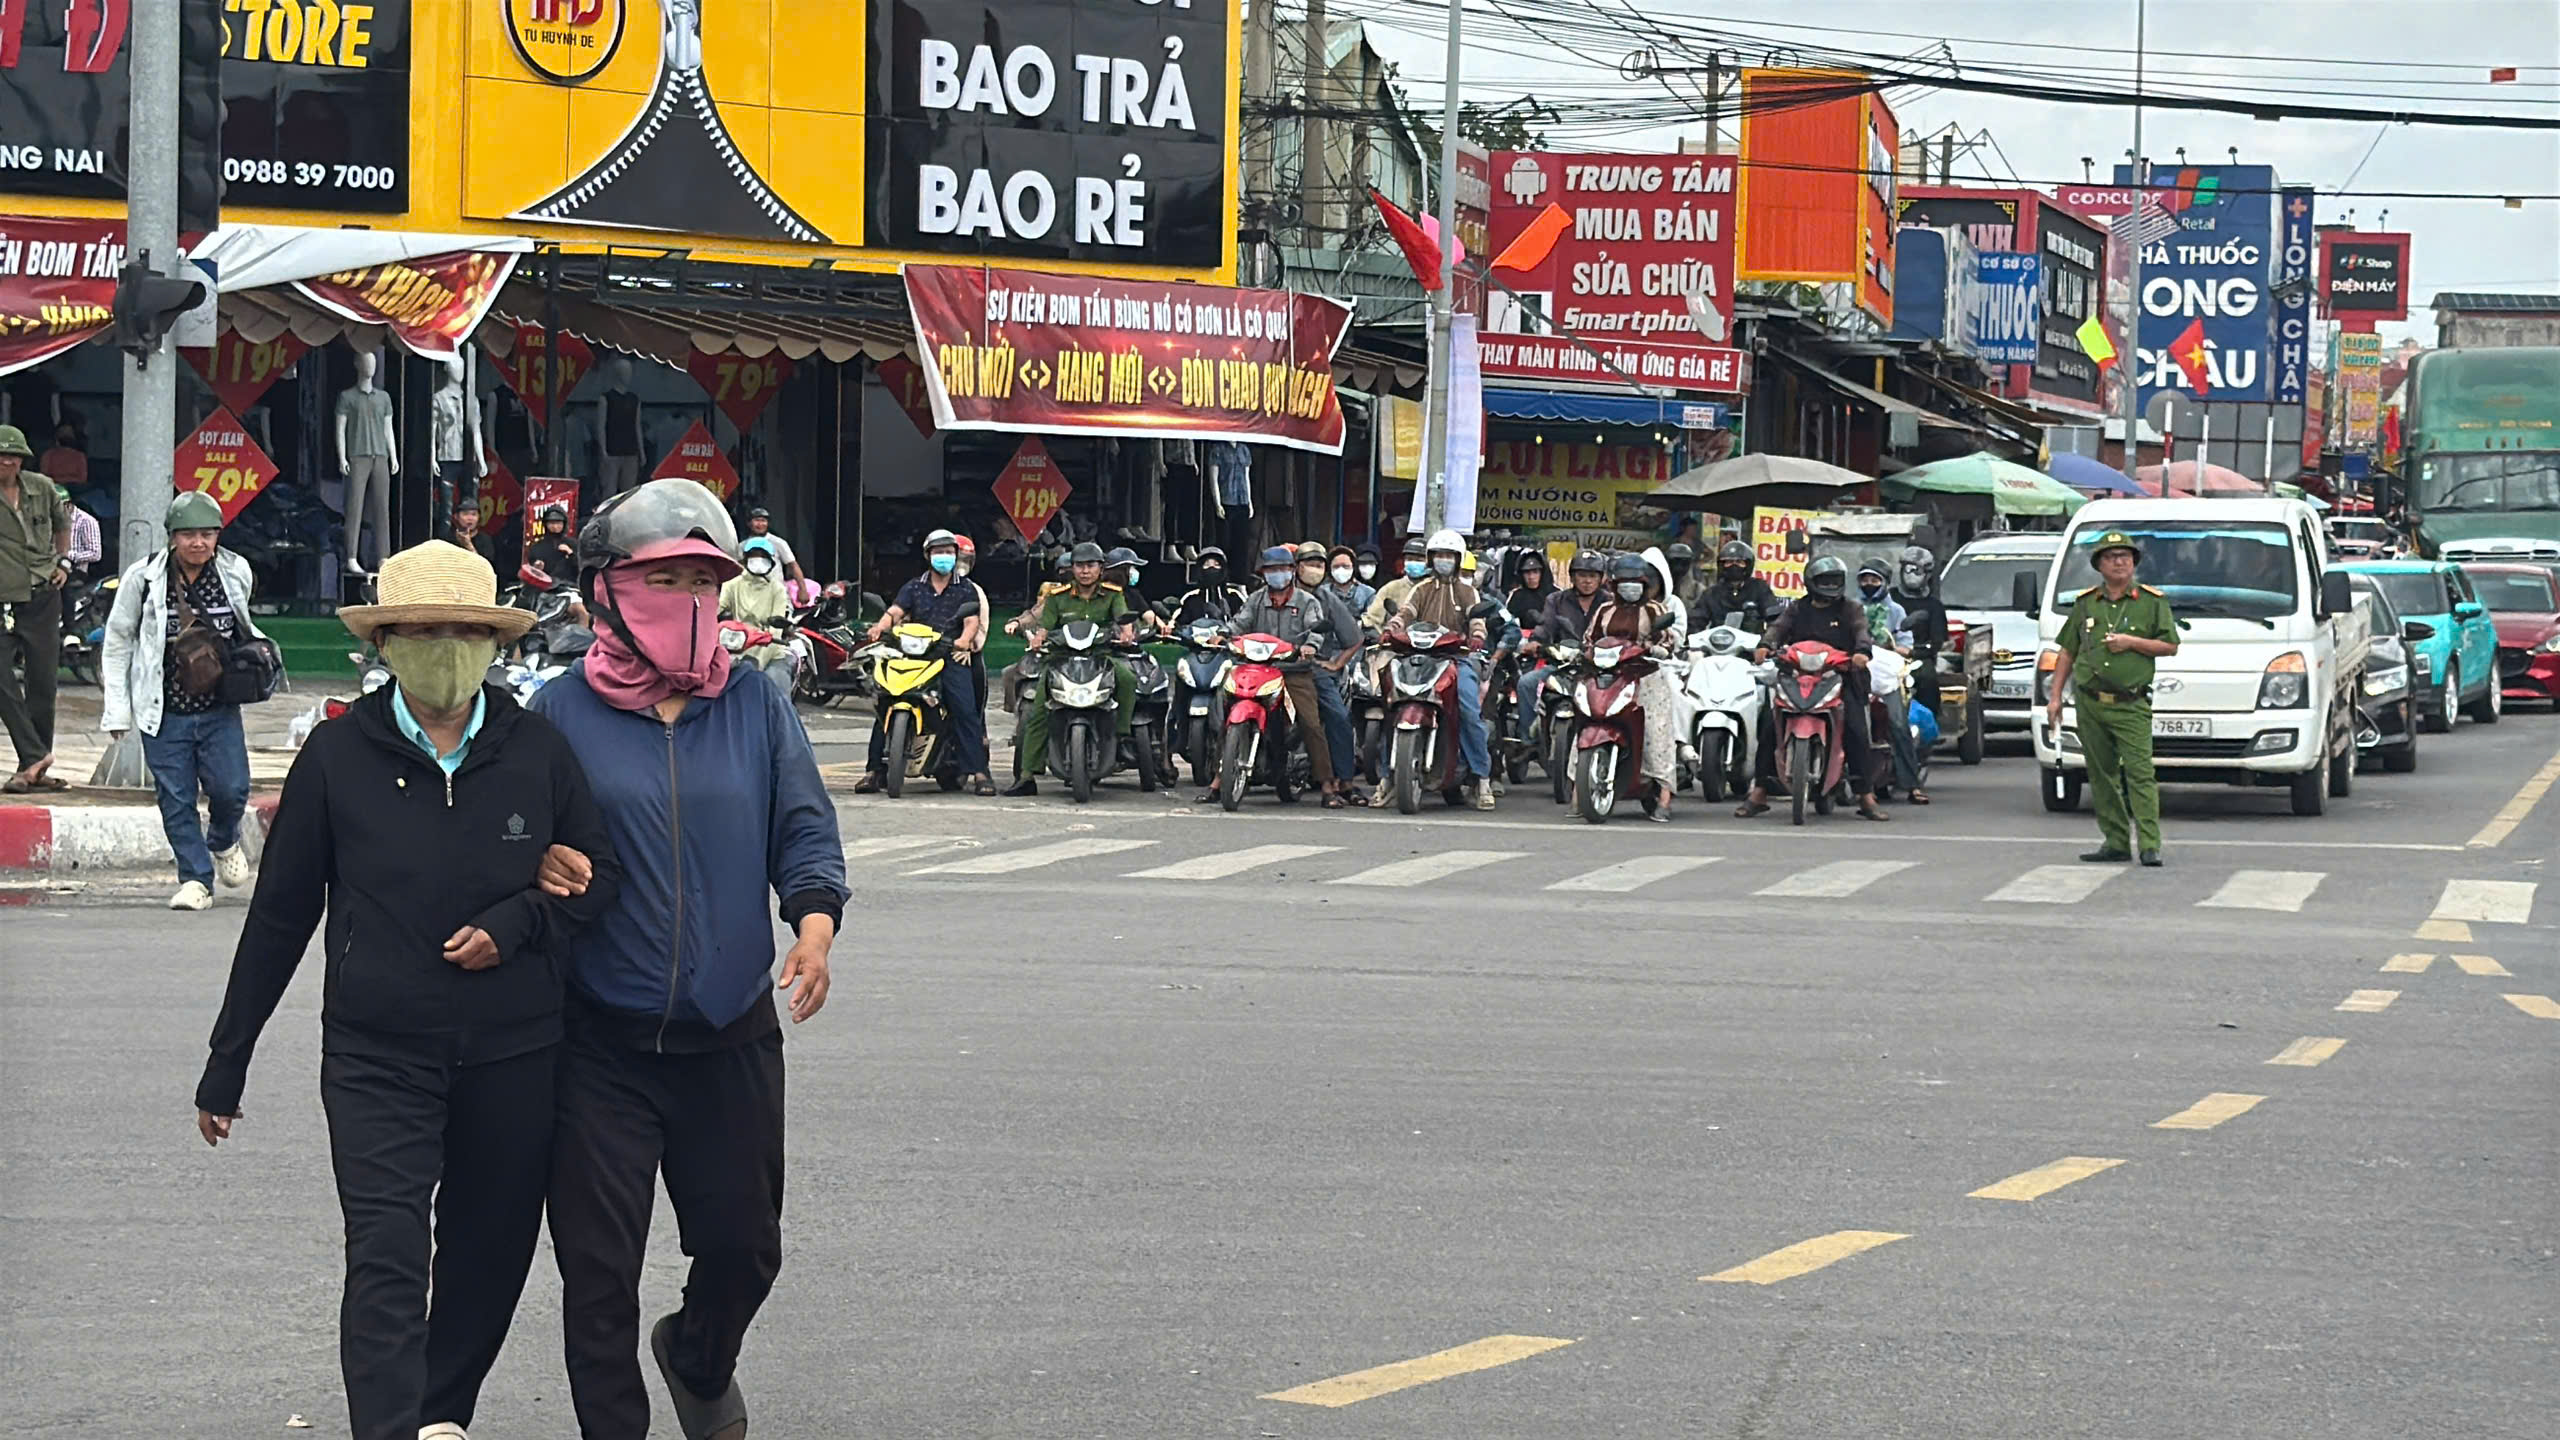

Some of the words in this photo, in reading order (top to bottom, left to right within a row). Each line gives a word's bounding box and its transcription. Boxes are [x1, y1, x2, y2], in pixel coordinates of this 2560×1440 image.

[525, 29, 537, 42] TU
[542, 31, 577, 46] HUYNH
[581, 36, 594, 48] DE
[920, 39, 1056, 116] BAO
[1075, 35, 1196, 130] TRẢ
[0, 146, 43, 170] NG
[55, 149, 104, 173] NAI
[223, 158, 287, 184] 0988
[294, 162, 326, 186] 39
[333, 165, 395, 190] 7000
[1565, 166, 1662, 192] TRUNG
[1671, 160, 1732, 193] TÂM
[919, 164, 1056, 240] BAO
[1076, 153, 1145, 247] RẺ
[1575, 208, 1642, 241] MUA
[1654, 201, 1718, 241] BÁN
[25, 240, 78, 277] BOM
[2177, 236, 2259, 265] THUỐC
[1572, 251, 1631, 296] SỬA
[1642, 258, 1717, 297] CHỮA
[2366, 278, 2397, 292] MÁY
[987, 287, 1010, 328] SỰ
[1012, 285, 1046, 330] KIỆN
[1049, 293, 1081, 326] BOM
[1084, 287, 1111, 327] TẤN
[1114, 293, 1150, 330] BÙNG
[1175, 298, 1193, 334] CÓ
[1195, 303, 1223, 336] ĐƠN
[1226, 302, 1242, 337] LÀ
[1245, 304, 1263, 339] CÓ
[1979, 271, 2038, 341] THUỐC
[2137, 276, 2258, 318] ONG
[1563, 307, 1725, 337] Smartpho
[1056, 340, 1105, 403] HÀNG
[1109, 344, 1143, 404] MỚI
[1181, 349, 1215, 408] ĐÓN
[1218, 351, 1260, 412] CHÀO
[1477, 343, 1513, 367] THAY
[1517, 342, 1554, 369] MÀN
[1642, 350, 1675, 378] ỨNG
[1710, 353, 1732, 382] RẺ
[205, 452, 237, 463] SALE
[1567, 444, 1668, 481] LAGI
[194, 467, 259, 502] 79k
[1508, 486, 1598, 504] NƯỚNG
[1528, 505, 1584, 522] NƯỚNG
